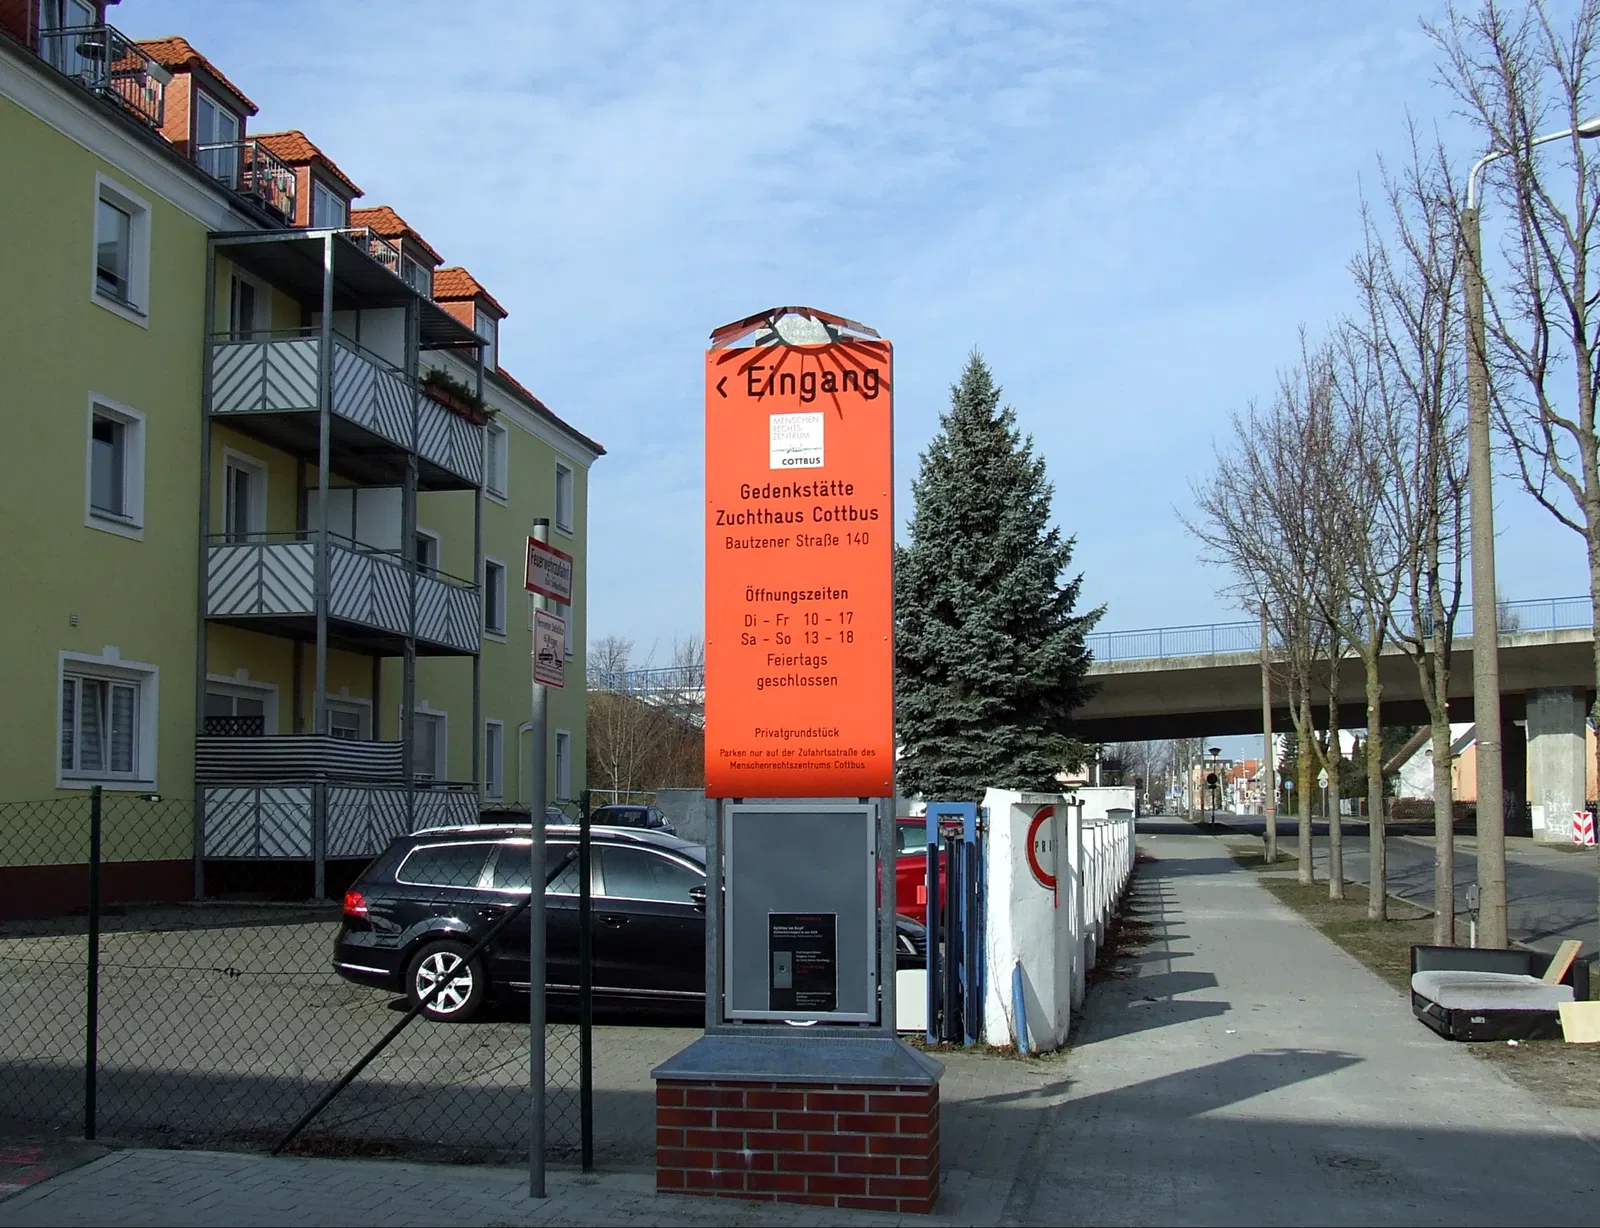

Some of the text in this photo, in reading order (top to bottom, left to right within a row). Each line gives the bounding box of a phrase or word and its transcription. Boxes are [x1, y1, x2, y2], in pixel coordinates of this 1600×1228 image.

[747, 366, 879, 403] Eingang
[772, 416, 820, 424] MENSCHEN
[772, 432, 811, 441] ZENTRUM
[781, 457, 821, 466] COTTBUS
[740, 480, 854, 500] Gedenkstätte
[716, 505, 879, 526] Zuchthaus Cottbus
[725, 532, 870, 550] Bautzener Straße 140
[745, 585, 849, 604] Öffnungszeiten
[744, 614, 757, 628] Di
[776, 613, 790, 627] Fr
[804, 612, 819, 626] 10
[839, 611, 854, 625] 17
[741, 632, 757, 646] Sa
[775, 631, 792, 645] So
[804, 630, 819, 644] 13
[839, 630, 854, 644] 18
[767, 652, 828, 668] Feiertags
[756, 674, 838, 690] geschlossen
[754, 727, 840, 741] Privatgrundstück
[719, 747, 876, 758] Parken nur auf der Zufahrtsstraße des
[730, 760, 866, 771] Menschenrechtszentrums Cottbus
